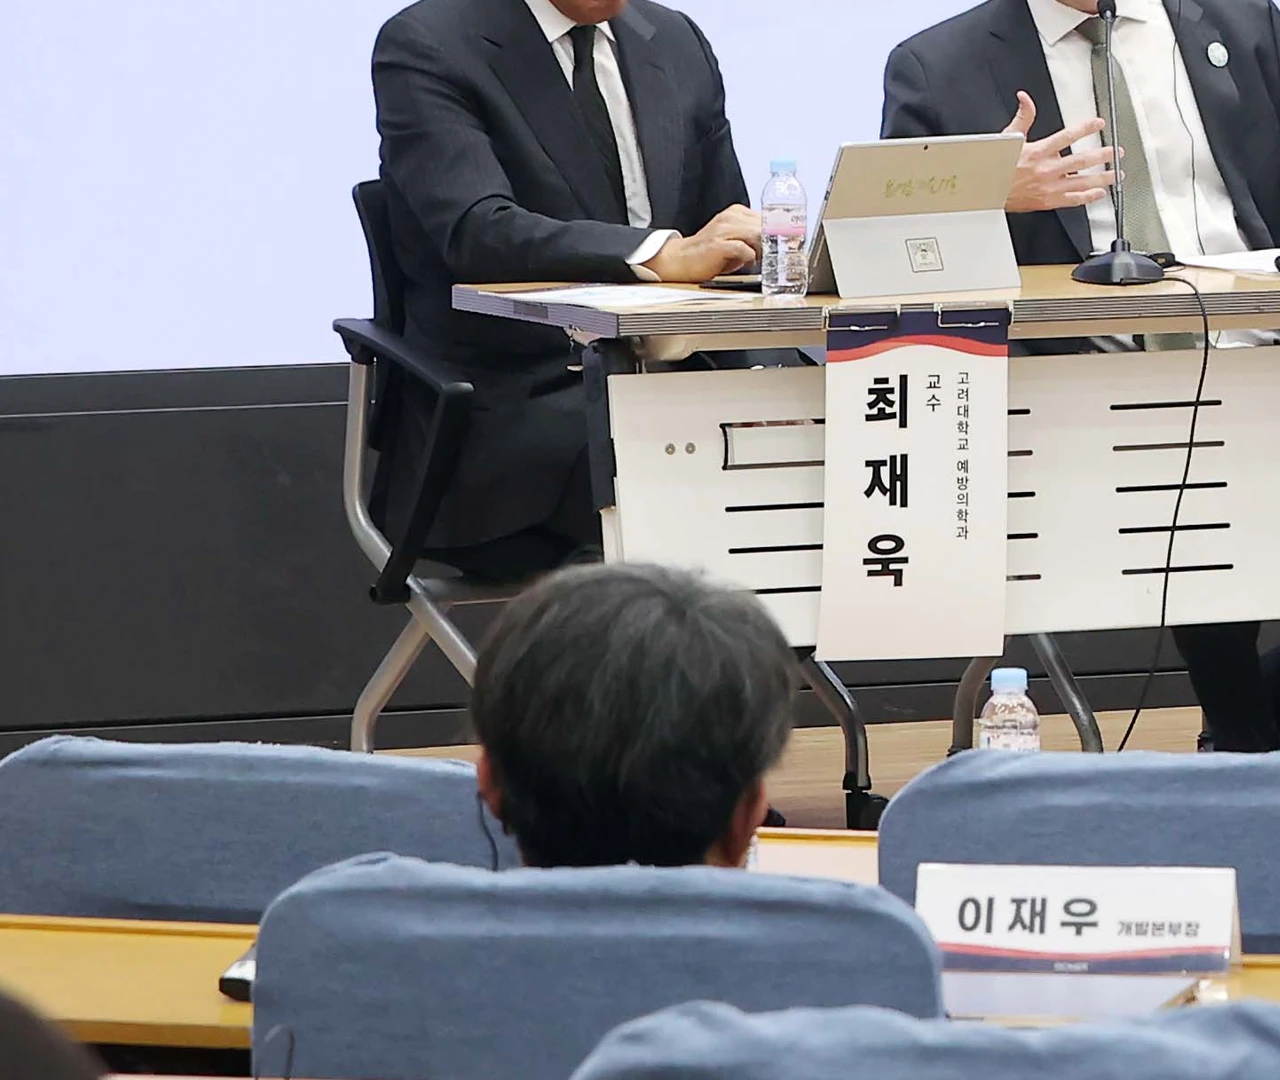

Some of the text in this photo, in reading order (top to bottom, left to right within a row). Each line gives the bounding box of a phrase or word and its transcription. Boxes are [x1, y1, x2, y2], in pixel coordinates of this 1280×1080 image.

[925, 374, 942, 412] 교수
[955, 371, 970, 540] 고려대학교 예방의학과
